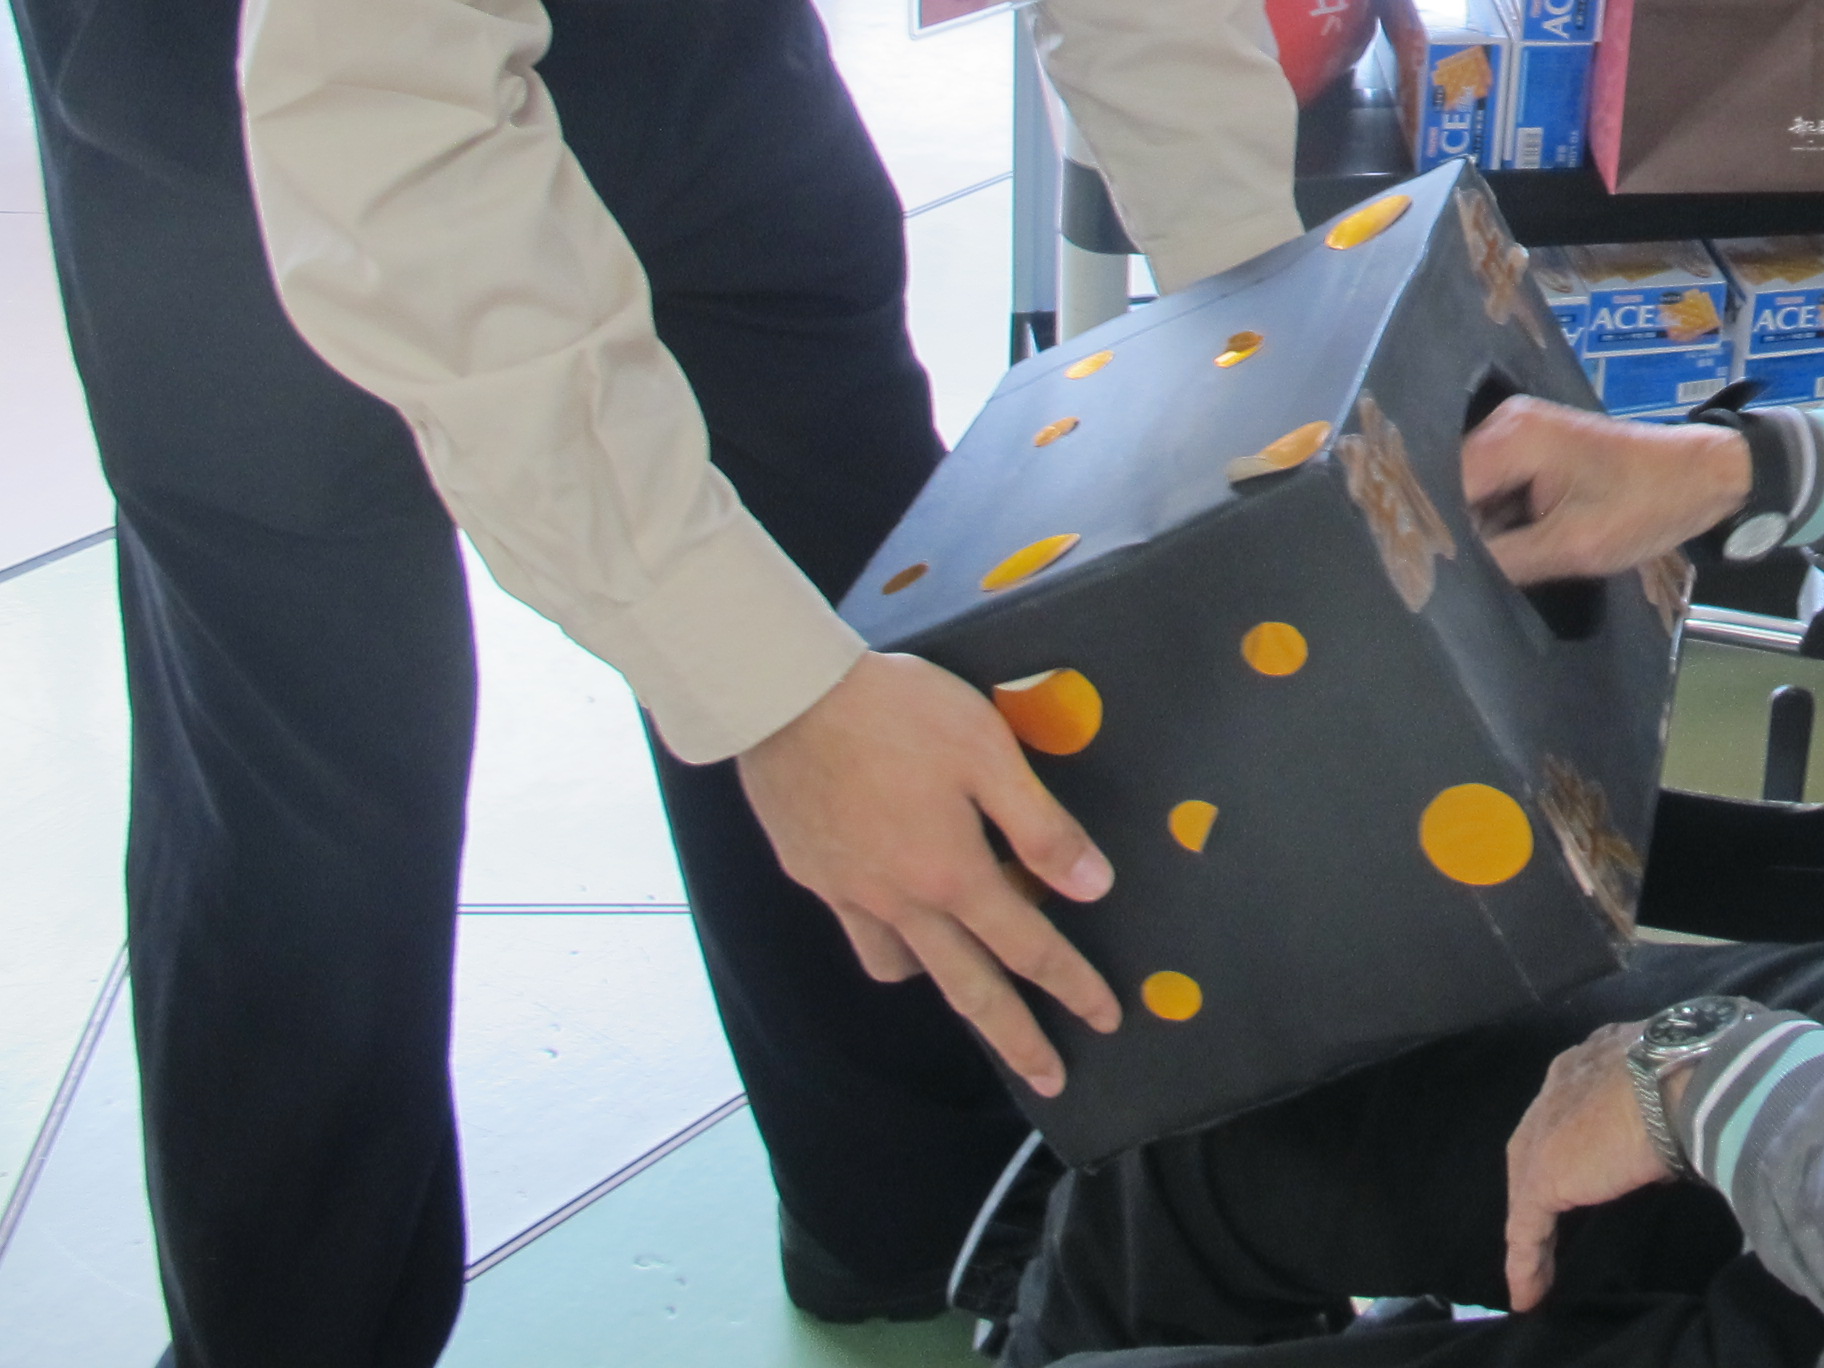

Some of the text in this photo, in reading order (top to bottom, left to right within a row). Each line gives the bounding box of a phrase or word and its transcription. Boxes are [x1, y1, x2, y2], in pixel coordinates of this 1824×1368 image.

[1440, 112, 1471, 155] CE
[1589, 305, 1656, 331] ACE
[1754, 305, 1818, 332] ACE
